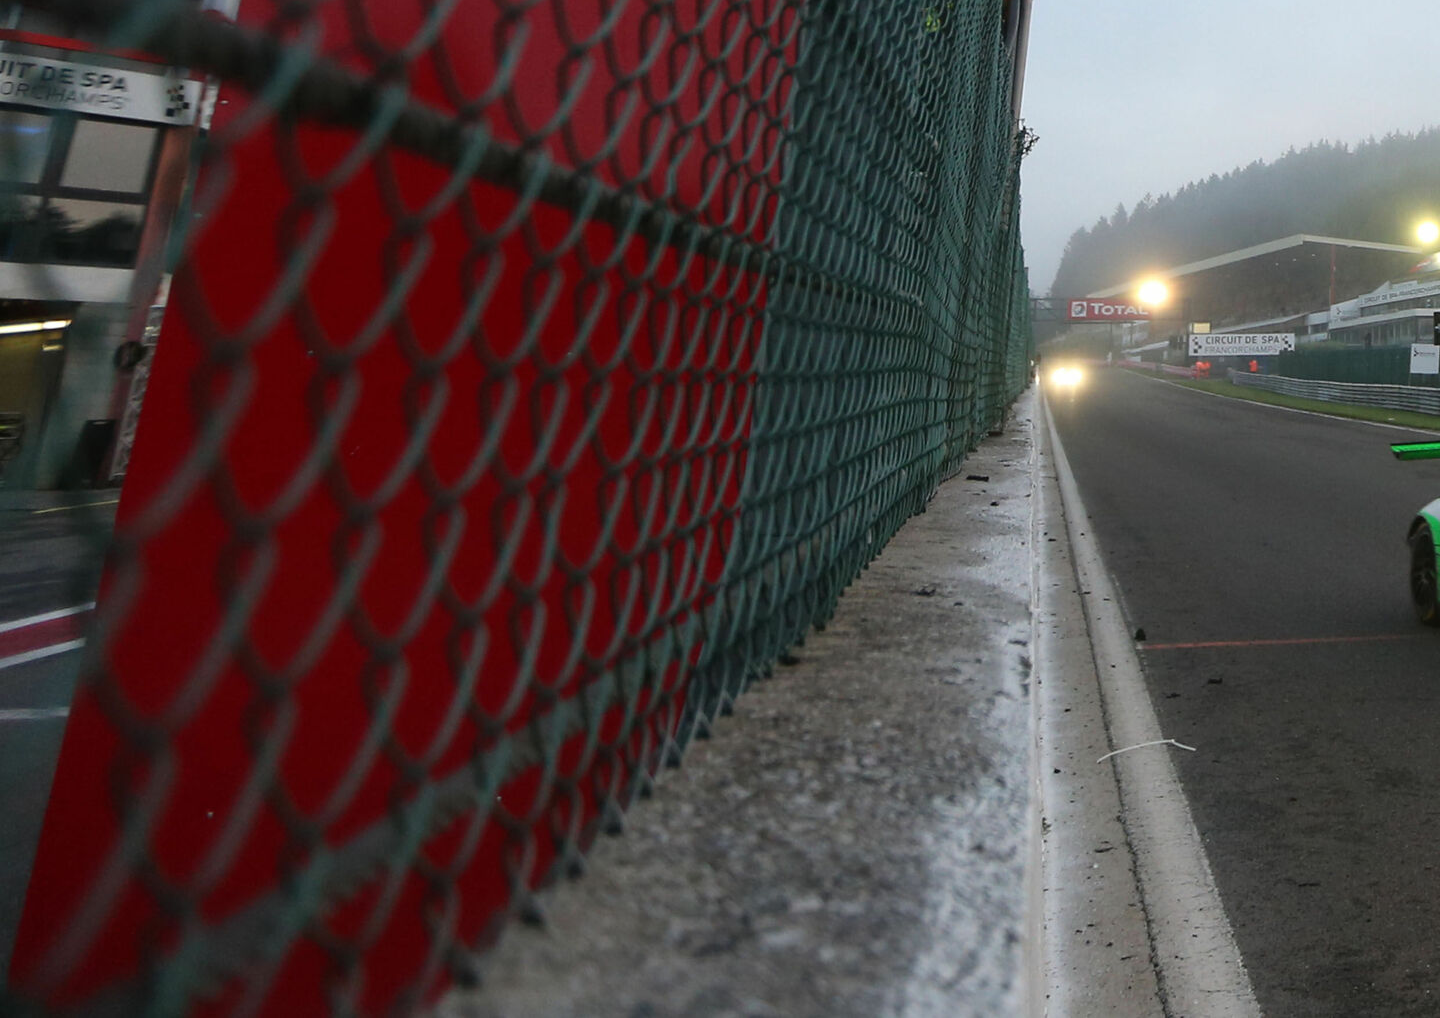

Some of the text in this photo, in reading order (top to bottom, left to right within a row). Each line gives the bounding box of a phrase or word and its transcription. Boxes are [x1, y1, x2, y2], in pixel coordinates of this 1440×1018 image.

[41, 65, 76, 85] DE
[80, 71, 129, 93] SPA
[1090, 302, 1149, 316] TOTAL
[1205, 335, 1280, 345] CIRCUIT DE SPA
